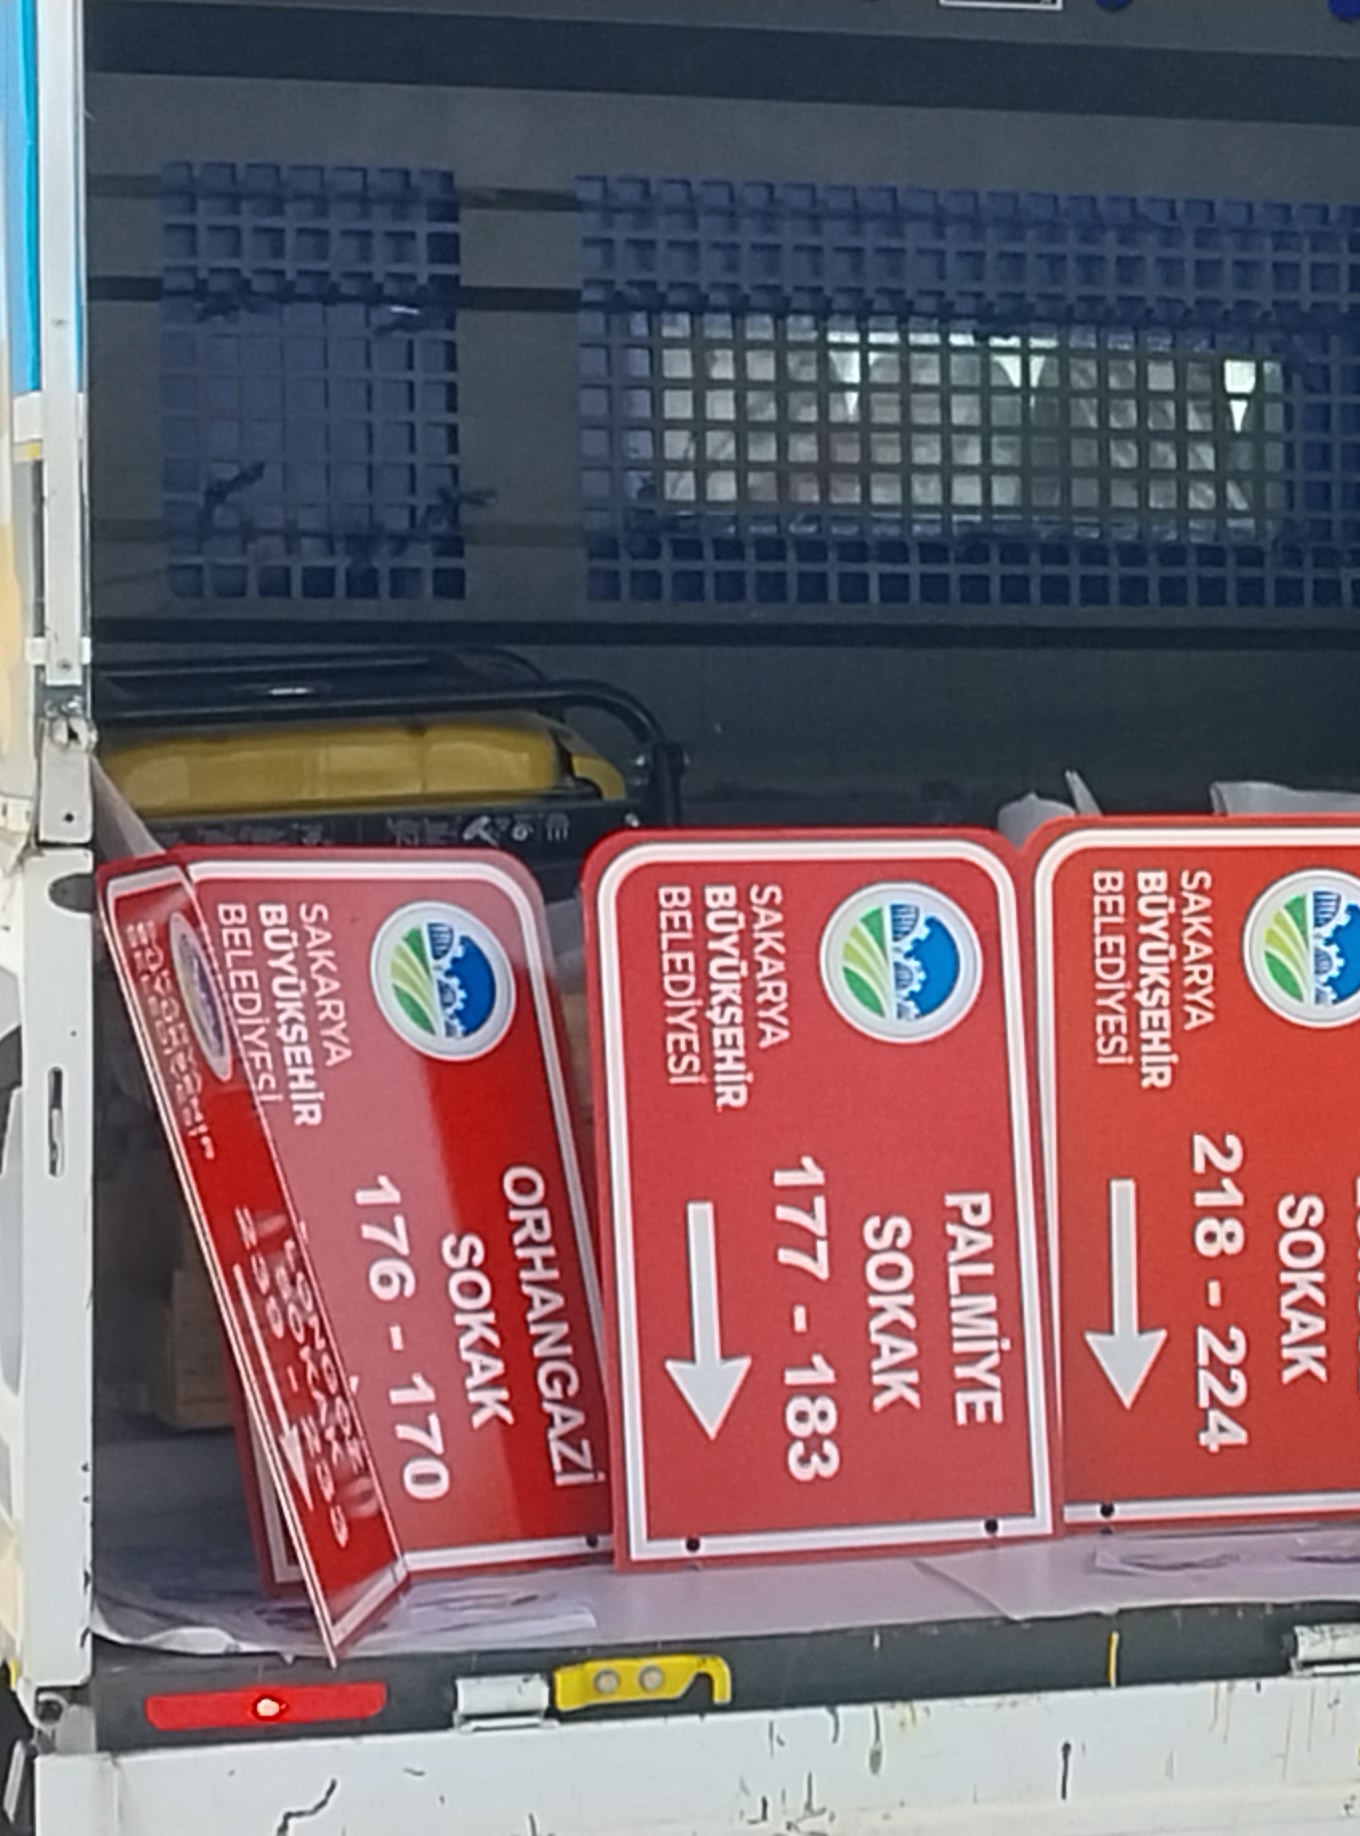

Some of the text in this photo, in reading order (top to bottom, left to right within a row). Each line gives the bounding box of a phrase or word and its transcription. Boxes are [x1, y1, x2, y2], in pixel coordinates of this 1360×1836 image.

[258, 903, 325, 1126] BÜYÜKŞEHİR
[299, 903, 353, 1067] SAKARYA
[657, 885, 709, 1084] BELEDİYESİ
[704, 884, 754, 1112] BÜYÜKŞEHİR
[749, 883, 791, 1049] SAKARYA
[1092, 870, 1134, 1065] BELEDİYESİ
[1133, 870, 1180, 1088] BÜYÜKŞEHİR
[1179, 869, 1216, 1031] SAKARYA
[354, 1174, 451, 1500] 176 - 170
[442, 1233, 515, 1429] SOKAK
[502, 1165, 606, 1486] ORHANGAZİ
[773, 1155, 840, 1482] 177 - 183
[862, 1213, 922, 1413] SOKAK
[944, 1191, 1012, 1426] PALMİYE
[1193, 1133, 1248, 1452] 218 - 224
[1277, 1193, 1328, 1385] SOKAK
